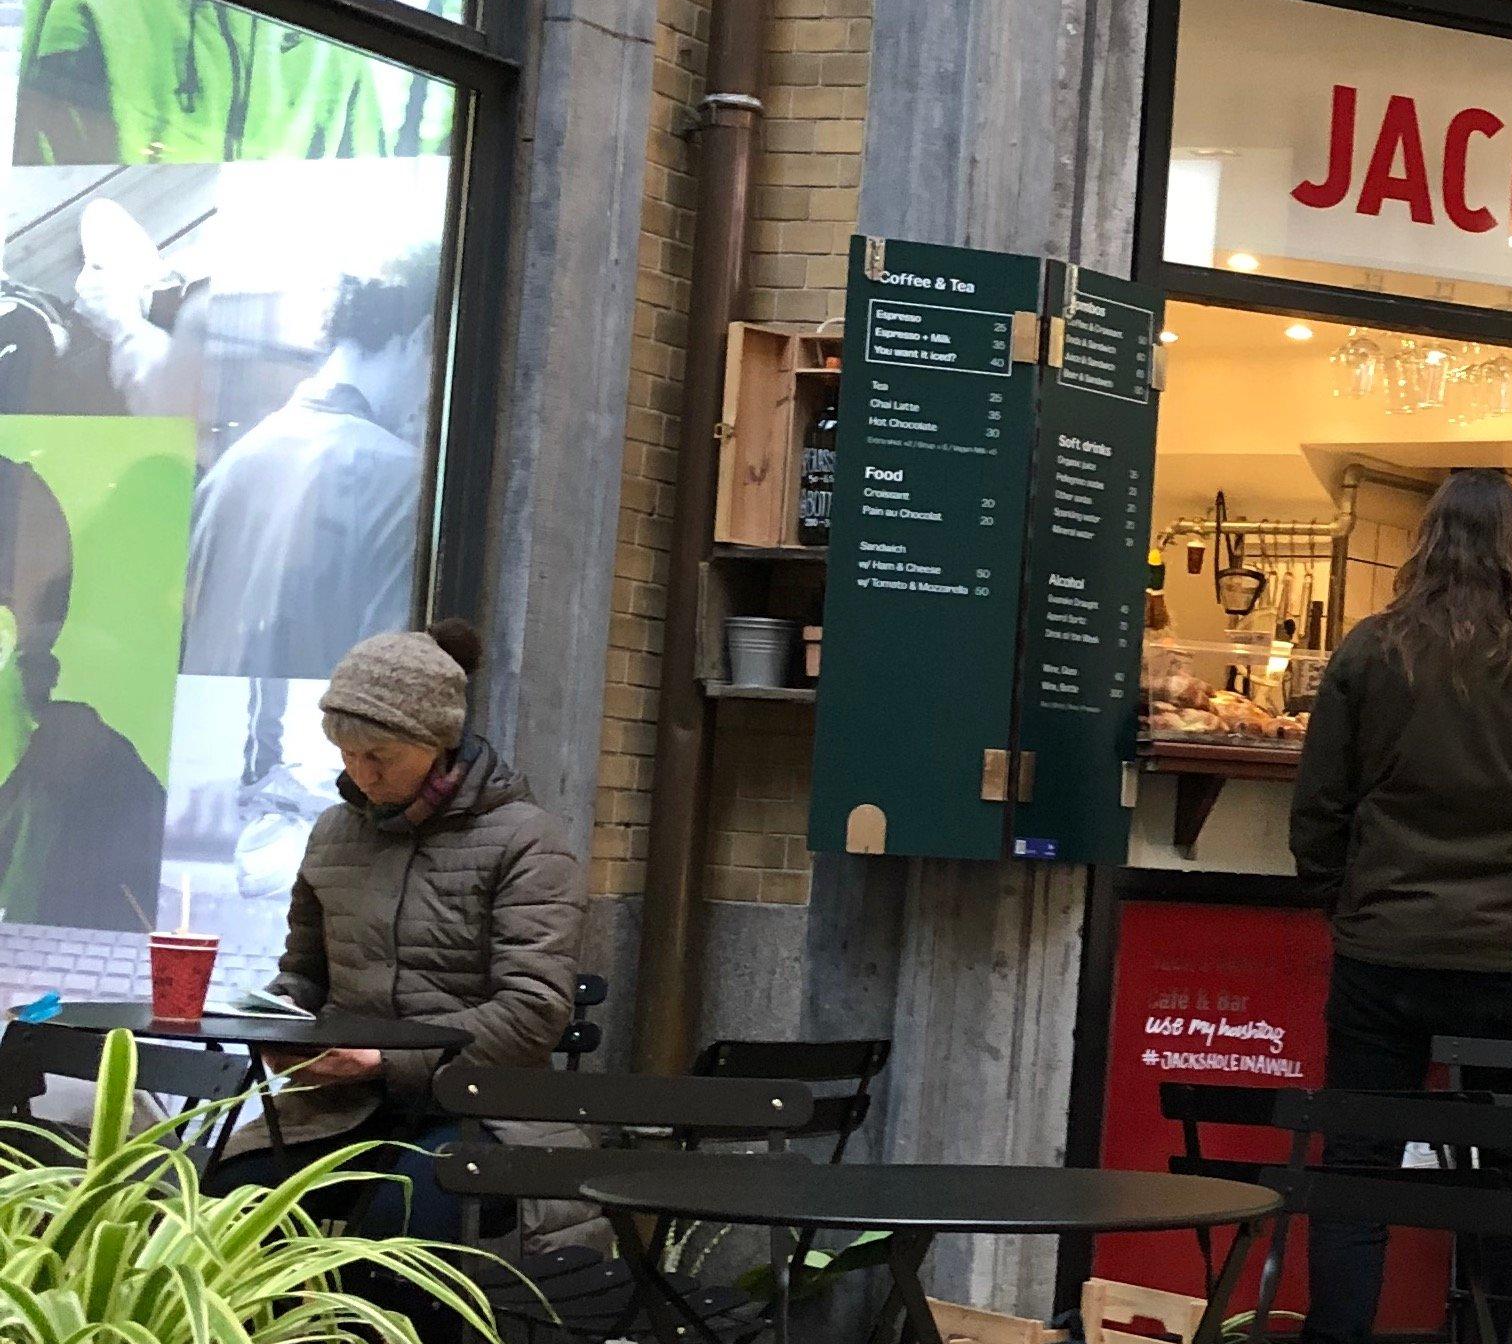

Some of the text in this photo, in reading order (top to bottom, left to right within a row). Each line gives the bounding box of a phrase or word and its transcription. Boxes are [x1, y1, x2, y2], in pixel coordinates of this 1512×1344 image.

[880, 270, 975, 294] Coffee & Tea
[1059, 435, 1113, 456] Soft drinks
[865, 466, 903, 481] Food
[1145, 1016, 1285, 1054] use my hashtag
